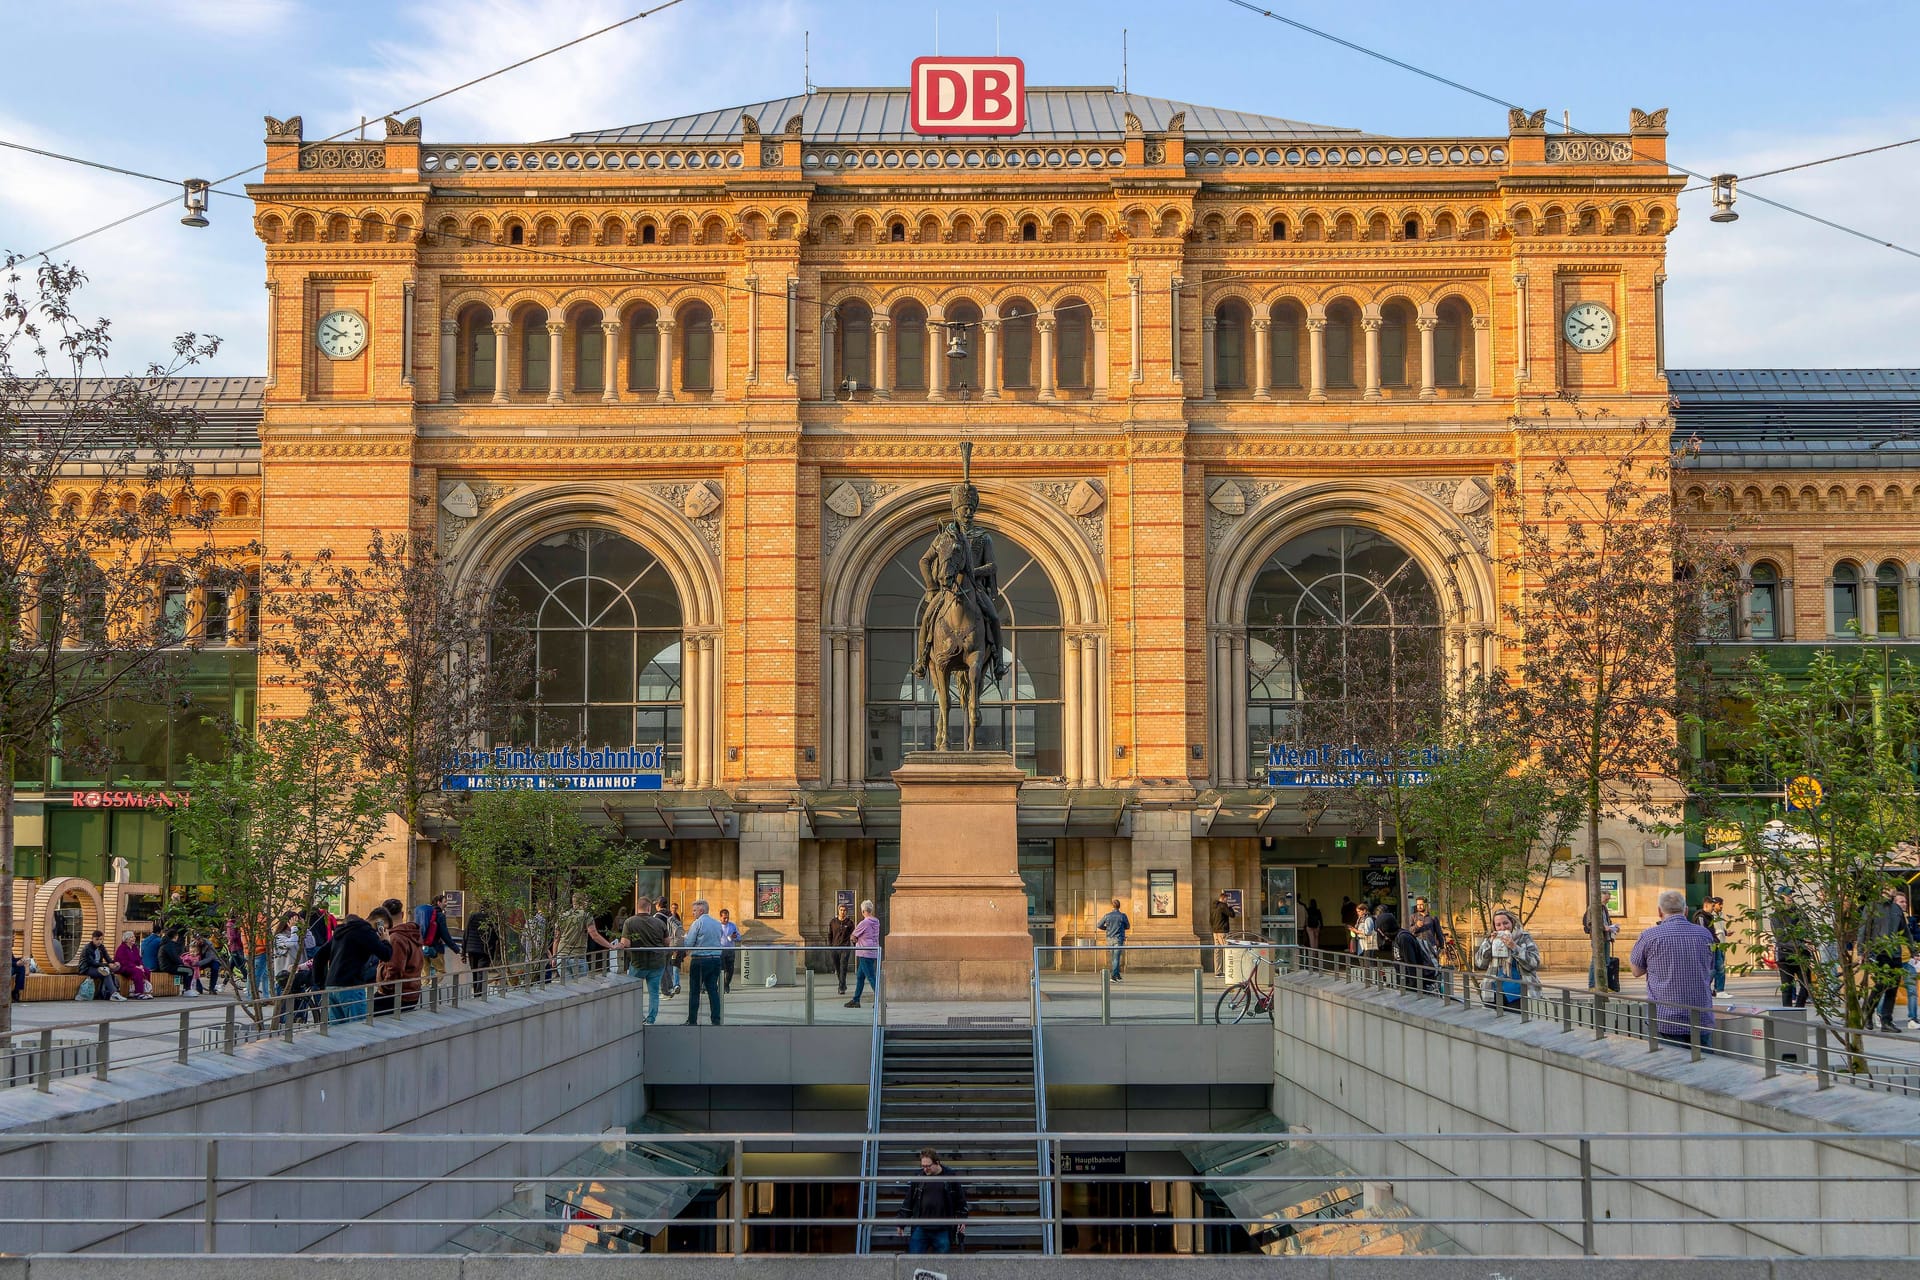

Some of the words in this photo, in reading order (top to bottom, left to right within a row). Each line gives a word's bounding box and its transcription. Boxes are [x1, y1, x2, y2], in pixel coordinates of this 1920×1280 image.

[925, 69, 1013, 121] DB
[495, 746, 663, 769] Einkaufsbahnhof
[72, 791, 190, 808] ROSSMANN
[1075, 1156, 1120, 1164] Hauptbahnhof
